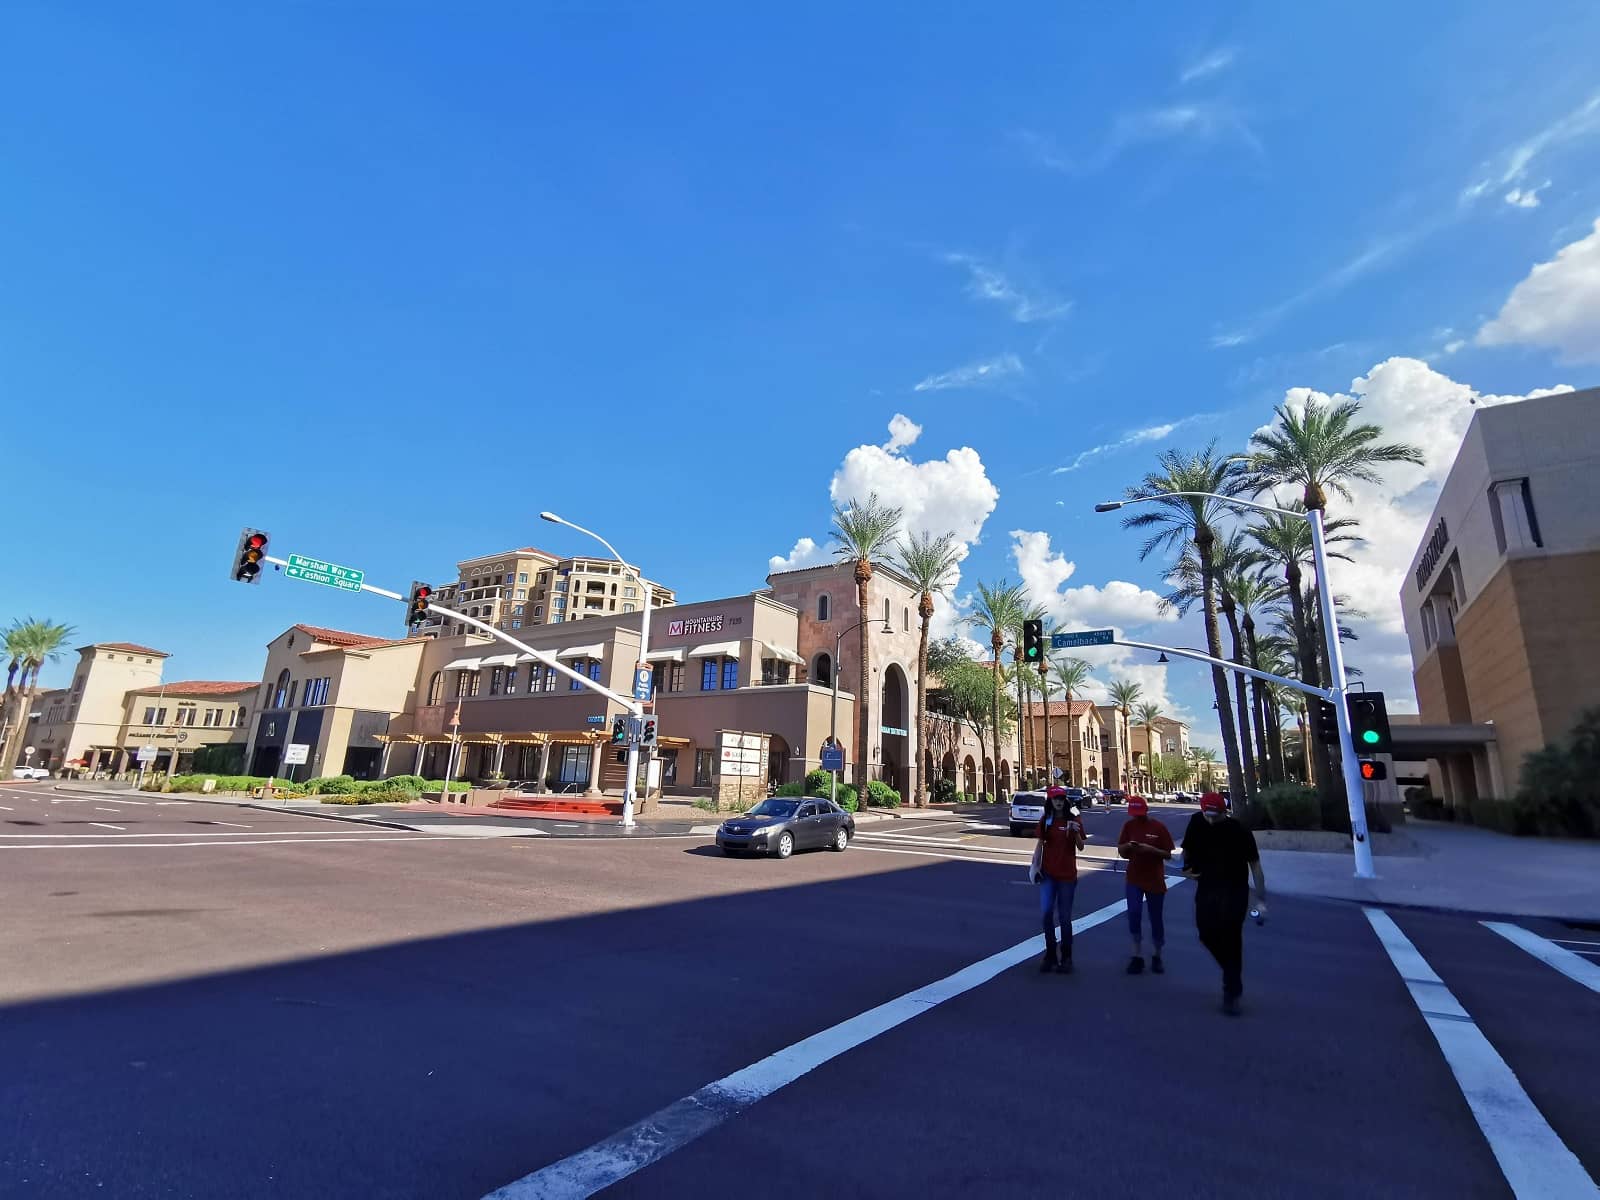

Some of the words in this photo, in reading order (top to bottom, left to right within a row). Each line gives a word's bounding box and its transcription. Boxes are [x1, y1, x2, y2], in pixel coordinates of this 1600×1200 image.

[296, 557, 328, 571] Marshall
[331, 566, 347, 578] Way
[299, 568, 330, 583] Fashion
[333, 577, 360, 589] Square
[685, 615, 723, 625] MOUNTAINSIDE
[685, 622, 723, 634] FITNESS
[1057, 637, 1098, 647] Camelback
